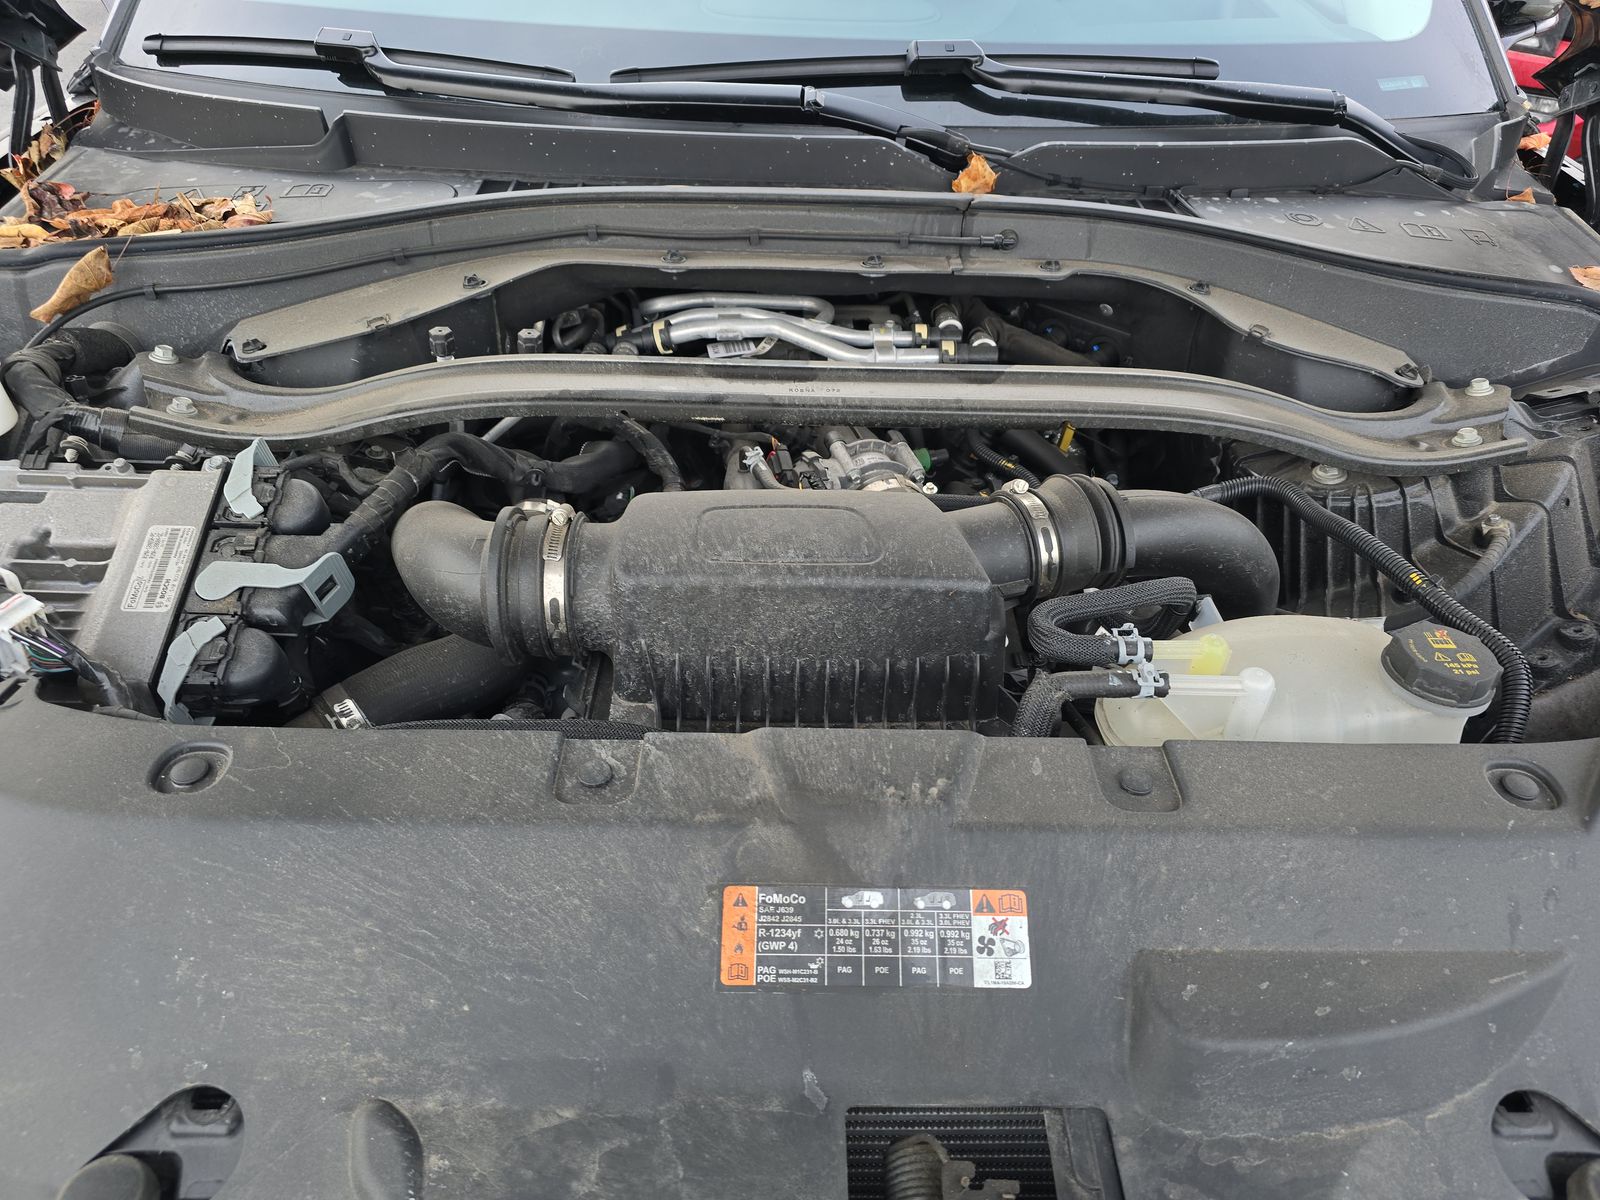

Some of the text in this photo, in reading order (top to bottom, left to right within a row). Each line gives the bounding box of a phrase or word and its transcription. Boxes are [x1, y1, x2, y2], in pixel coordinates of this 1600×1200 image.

[159, 578, 172, 599] BOSCH
[758, 893, 807, 904] FoMoCo
[758, 928, 802, 939] R-1234yf
[828, 928, 860, 938] 0.680 kg
[864, 929, 896, 939] 0.737 kg
[903, 929, 935, 939] 0.992 kg
[940, 930, 971, 940] 0.992 kg
[758, 941, 798, 952] (GWP 4)
[757, 966, 777, 974] PAG
[874, 966, 889, 974] POE
[757, 975, 777, 983] POE
